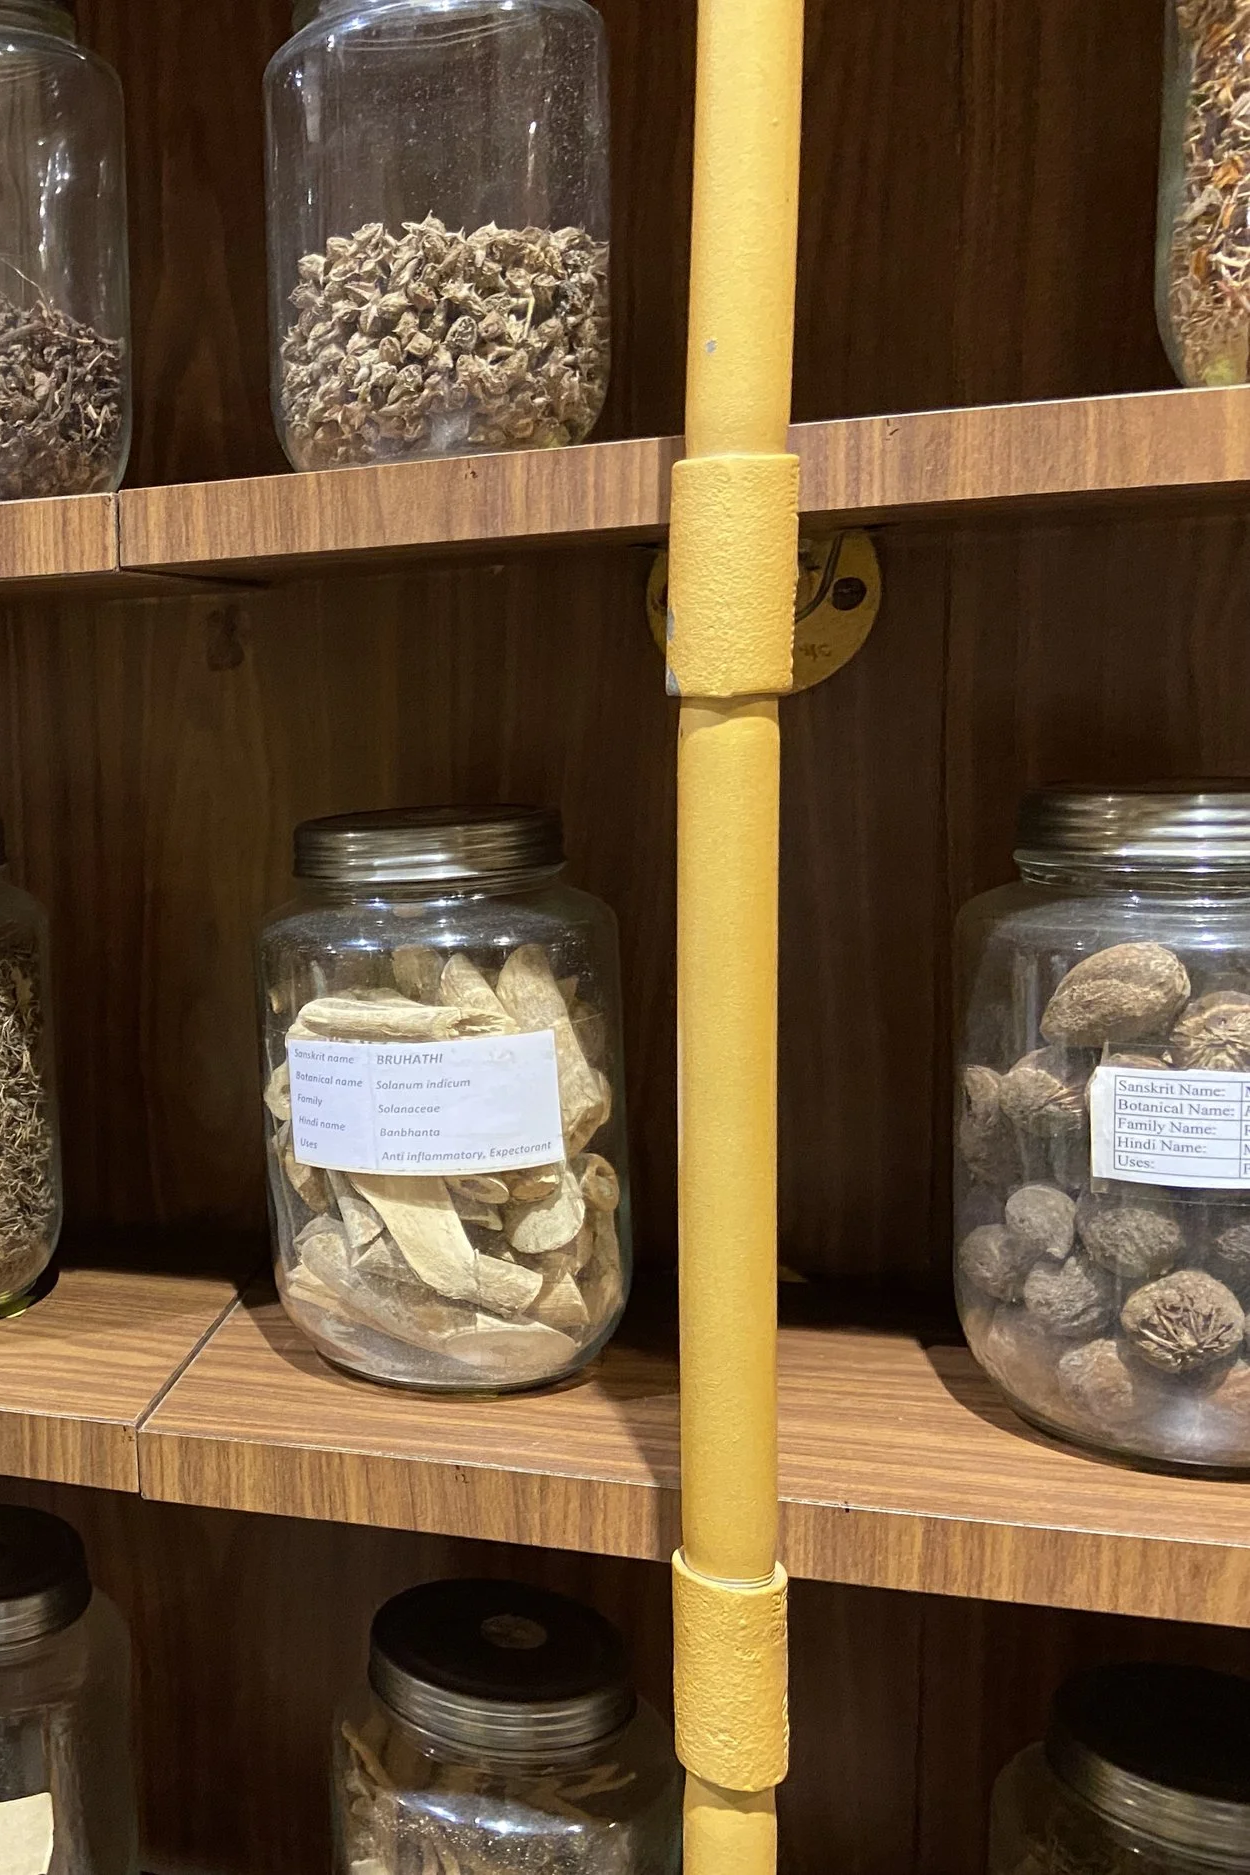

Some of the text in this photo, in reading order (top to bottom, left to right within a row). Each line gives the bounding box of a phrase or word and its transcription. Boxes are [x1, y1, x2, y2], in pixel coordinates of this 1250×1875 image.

[294, 1048, 354, 1064] Sanskrit name
[376, 1053, 443, 1066] BRUHATHI
[296, 1071, 363, 1088] Botanical name
[376, 1077, 471, 1091] Solanum indicum
[1118, 1080, 1226, 1097] Sanskrit Name:
[297, 1093, 323, 1107] Family
[1118, 1098, 1184, 1114] Botanical
[1189, 1103, 1235, 1117] Name:
[378, 1103, 441, 1114] Solanaceae
[299, 1115, 346, 1132] Hindi name
[1118, 1117, 1217, 1135] Family Name:
[380, 1127, 440, 1138] Banbhanta
[300, 1138, 318, 1150] Uses
[381, 1150, 404, 1161] Anti
[489, 1141, 552, 1158] Expectorant
[1118, 1136, 1207, 1154] Hindi Name:
[1118, 1155, 1155, 1169] Uses:
